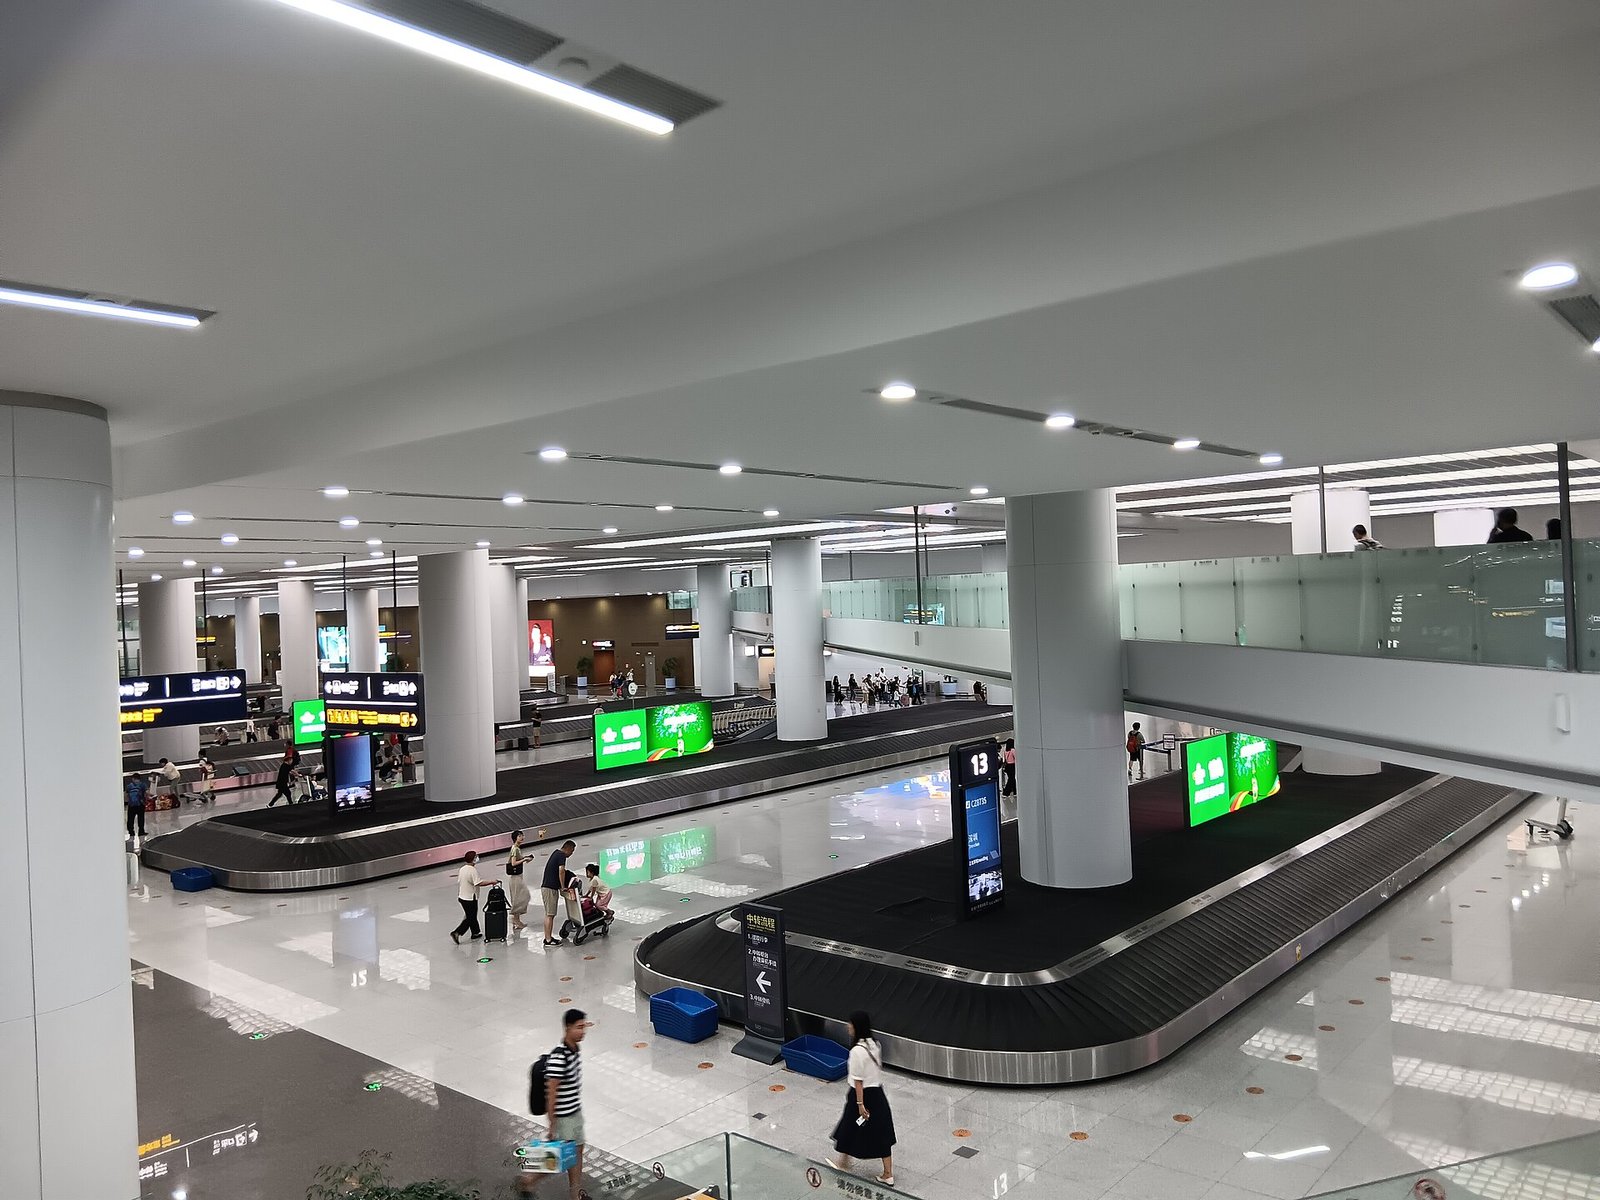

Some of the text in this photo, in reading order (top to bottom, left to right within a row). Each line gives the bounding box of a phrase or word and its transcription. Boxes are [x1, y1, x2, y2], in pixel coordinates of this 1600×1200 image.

[971, 752, 989, 776] 13
[746, 913, 776, 929] 中转流程
